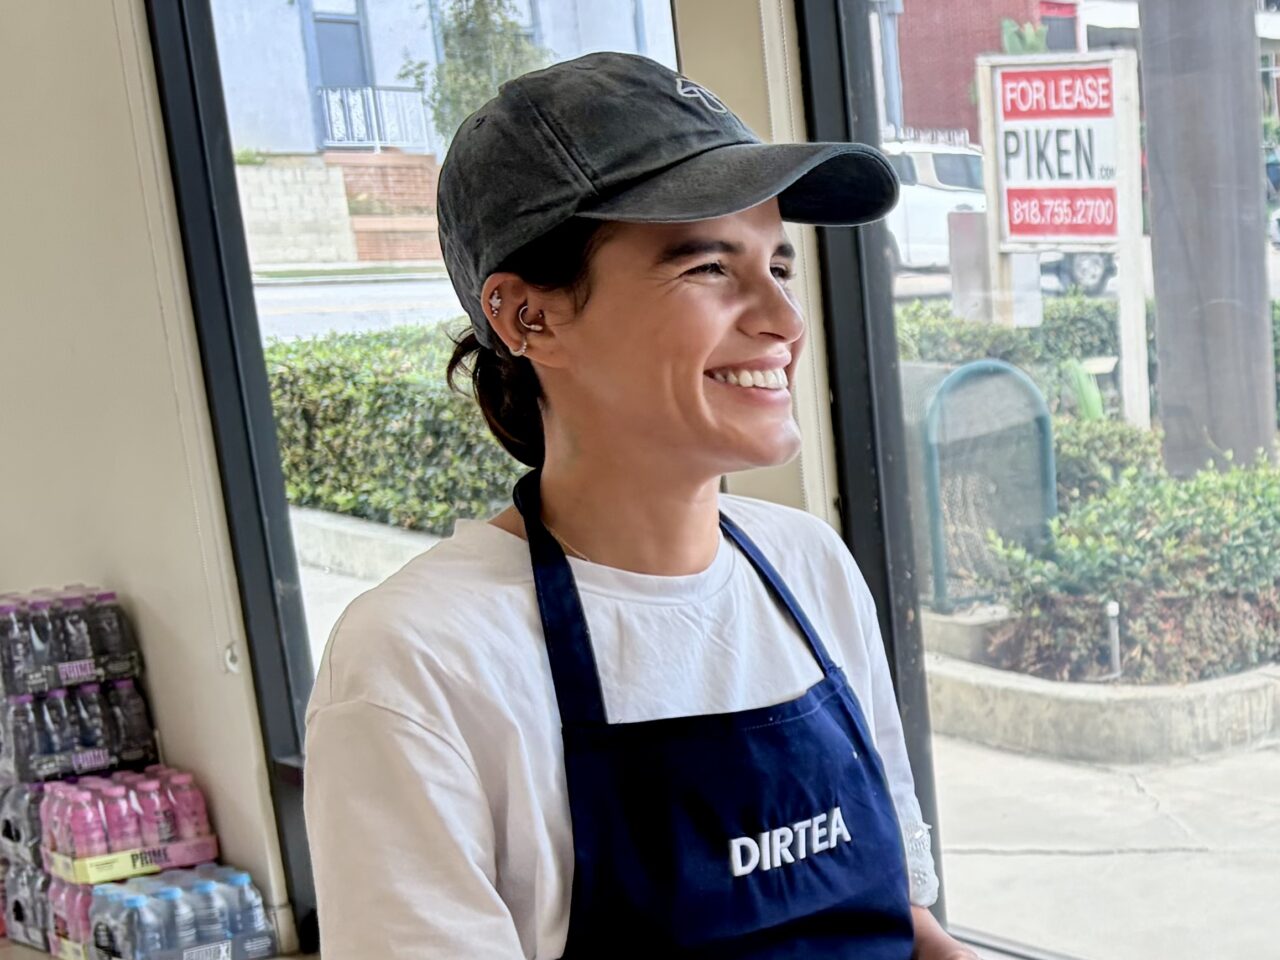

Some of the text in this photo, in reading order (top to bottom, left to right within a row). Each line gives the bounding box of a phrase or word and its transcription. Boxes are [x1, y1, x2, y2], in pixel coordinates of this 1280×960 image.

[1004, 76, 1112, 112] FOR LEASE
[1003, 128, 1095, 181] PIKEN
[1012, 197, 1114, 225] 818.755.2700
[130, 850, 170, 870] PRIME
[730, 806, 851, 878] DIRTEA
